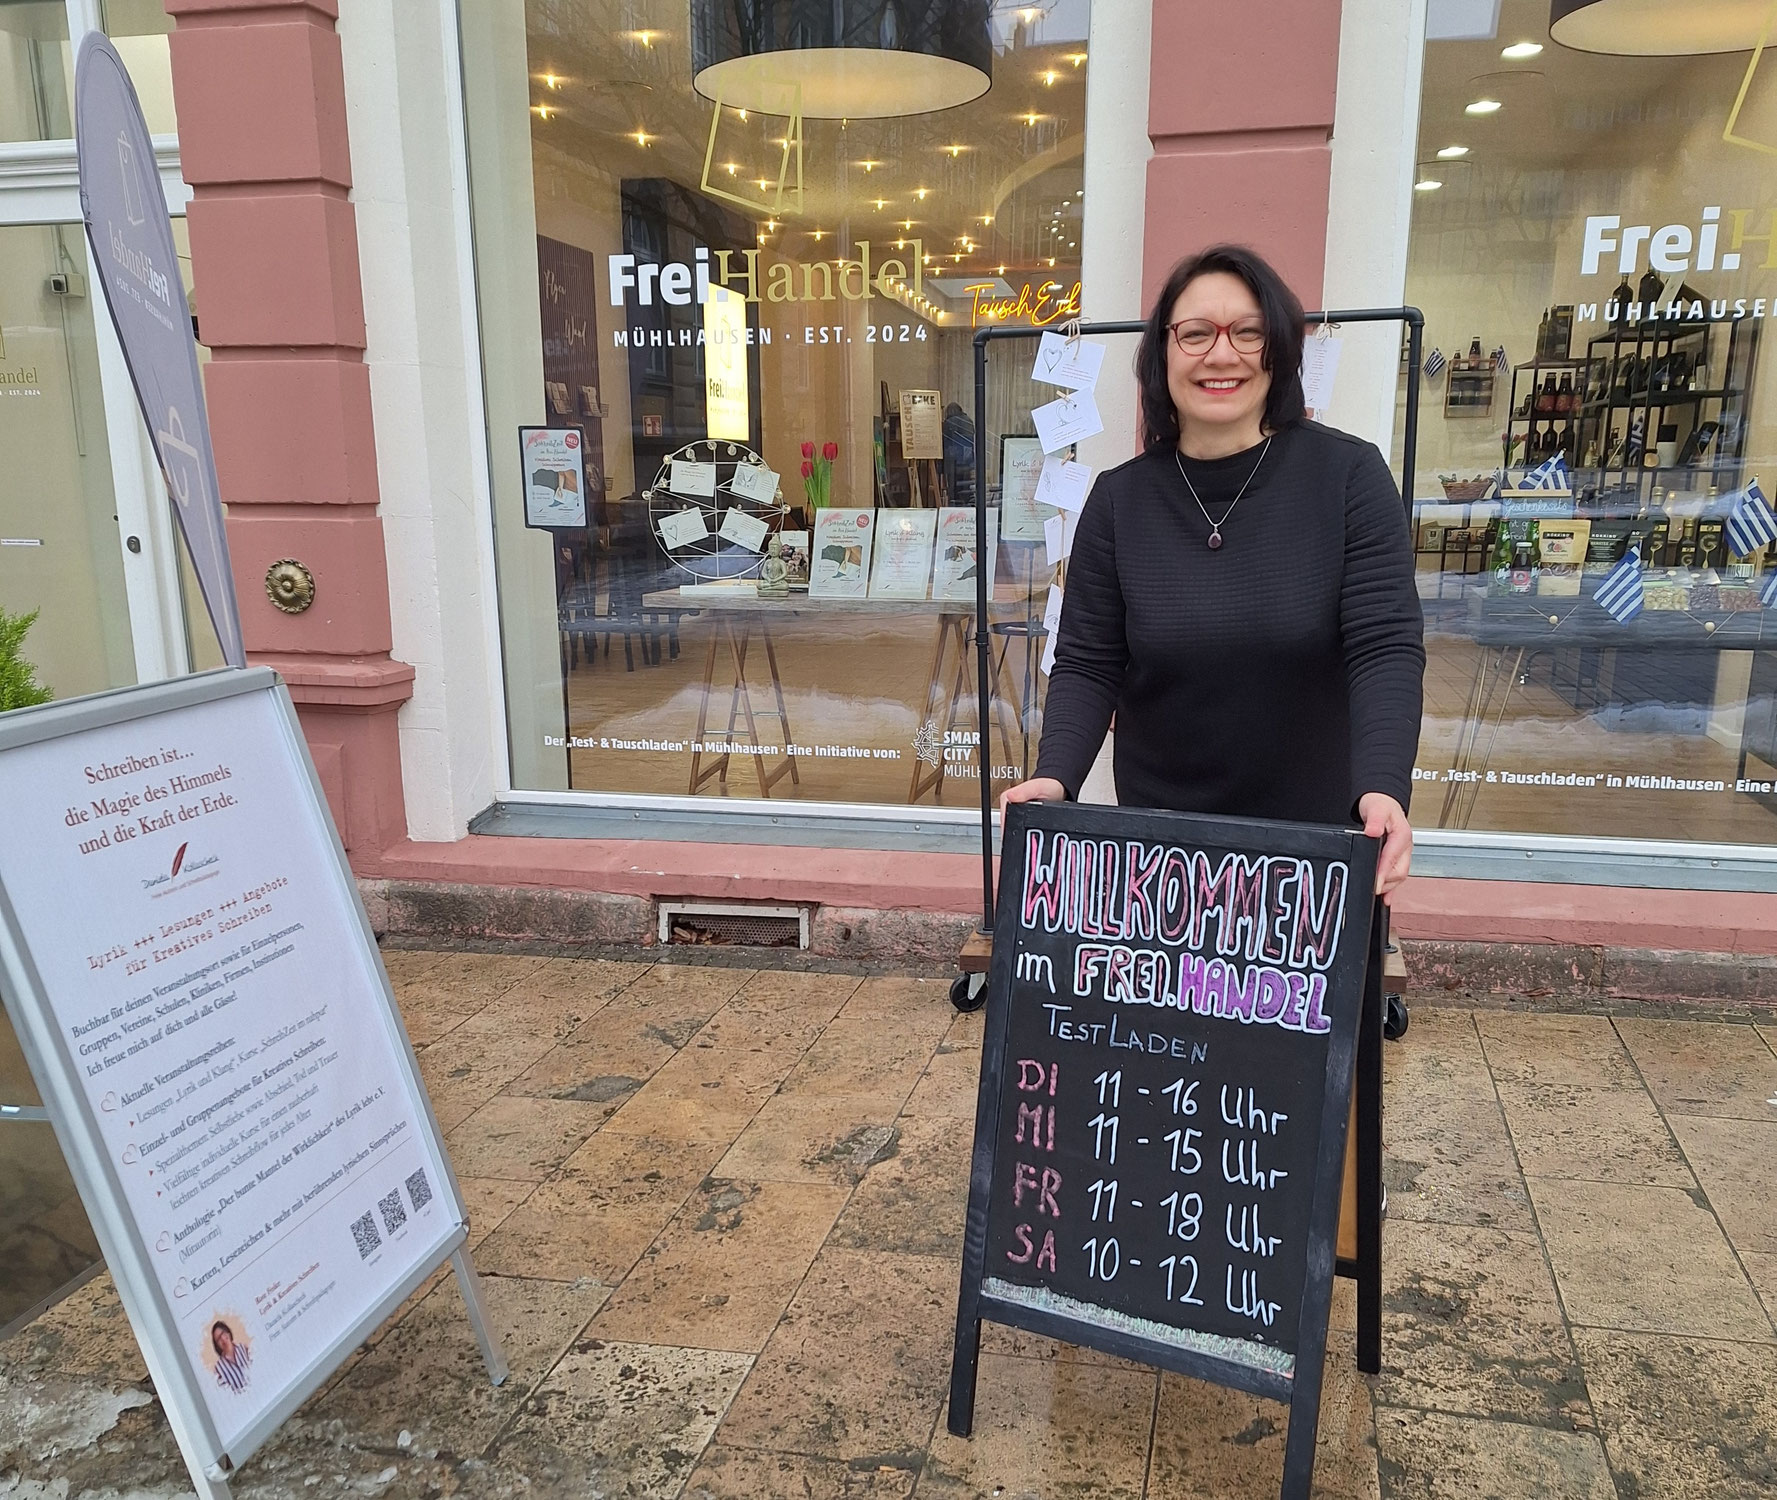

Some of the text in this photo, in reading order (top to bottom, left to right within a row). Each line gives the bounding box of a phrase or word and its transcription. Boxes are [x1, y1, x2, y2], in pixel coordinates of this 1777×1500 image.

[608, 238, 926, 306] Frei.Handel
[613, 323, 929, 348] MÜHLHAUSEN EST. 2024
[1578, 298, 1777, 322] MÜHLHAUSE
[905, 406, 916, 452] TAUSCH
[83, 755, 160, 784] Schreiben
[544, 735, 564, 746] Der
[600, 738, 610, 748] &
[611, 738, 689, 751] Tauschladen“
[691, 741, 702, 752] in
[705, 741, 778, 755] Mühlhausen
[786, 744, 811, 756] Eine
[815, 745, 871, 758] Initiative
[873, 749, 901, 759] von:
[943, 731, 981, 744] SMAR
[943, 748, 972, 761] CITY
[64, 764, 231, 826] die Magie des Himmels
[1412, 767, 1438, 781] Der
[1486, 771, 1498, 783] &
[1500, 771, 1604, 787] Tauschladen“
[1607, 773, 1623, 788] in
[1626, 775, 1725, 791] Mühlhausen
[1736, 781, 1771, 793] Eine
[78, 791, 238, 854] und die Kraft der Erde.
[86, 944, 128, 969] Lyrik
[158, 908, 214, 938] Lesungen
[242, 877, 288, 903] Angebote
[1021, 828, 1349, 970] WILLKOMMEN
[125, 903, 272, 976] für Kreatives Schreiben
[1015, 940, 1057, 993] im
[70, 1014, 110, 1038] Buchbar
[110, 1006, 124, 1019] für
[124, 993, 154, 1012] deinen
[151, 961, 220, 997] Veranstaltungsort
[219, 949, 241, 966] sowie
[239, 945, 251, 956] für
[78, 943, 295, 1056] Gruppen, Vereine, Schulen, Kliniken, Firmen, Institutionen
[86, 1058, 107, 1077] Ich
[102, 1051, 127, 1068] freue
[126, 1037, 150, 1056] mich
[149, 1027, 163, 1044] auf
[164, 1019, 184, 1035] dich
[183, 1009, 200, 1025] und
[199, 1004, 213, 1017] alle
[120, 1082, 155, 1108] Aktuelle
[135, 1096, 174, 1123] Lesungen
[197, 1070, 212, 1087] und
[138, 1132, 169, 1157] Einzel-
[169, 1119, 187, 1137] und
[185, 1082, 251, 1126] Gruppenangebote
[251, 1075, 263, 1087] für
[261, 1056, 293, 1080] Kreatives
[1016, 1059, 1059, 1097] DI
[1093, 1070, 1123, 1108] 11
[1161, 1077, 1200, 1115] 16
[1220, 1084, 1289, 1136] Uhr
[173, 1208, 216, 1244] Anthologie
[233, 1179, 256, 1199] bunte
[280, 1152, 293, 1165] der
[335, 1115, 345, 1127] des
[1014, 1102, 1057, 1153] MI
[1087, 1112, 1120, 1166] 11
[1163, 1127, 1203, 1175] 15
[1221, 1138, 1289, 1192] Uhr
[189, 1266, 221, 1291] Karten,
[218, 1229, 265, 1268] Lesezeichen
[264, 1222, 272, 1233] &
[272, 1208, 291, 1227] mehr
[290, 1198, 304, 1213] mit
[302, 1168, 343, 1203] berührenden
[1014, 1160, 1063, 1218] FR
[1087, 1179, 1118, 1222] 11
[1159, 1191, 1203, 1241] 18
[1225, 1203, 1283, 1257] Uhr
[1006, 1223, 1057, 1274] SA
[1081, 1237, 1121, 1281] 10
[1158, 1254, 1204, 1306] 12
[1226, 1263, 1283, 1327] Uhr
